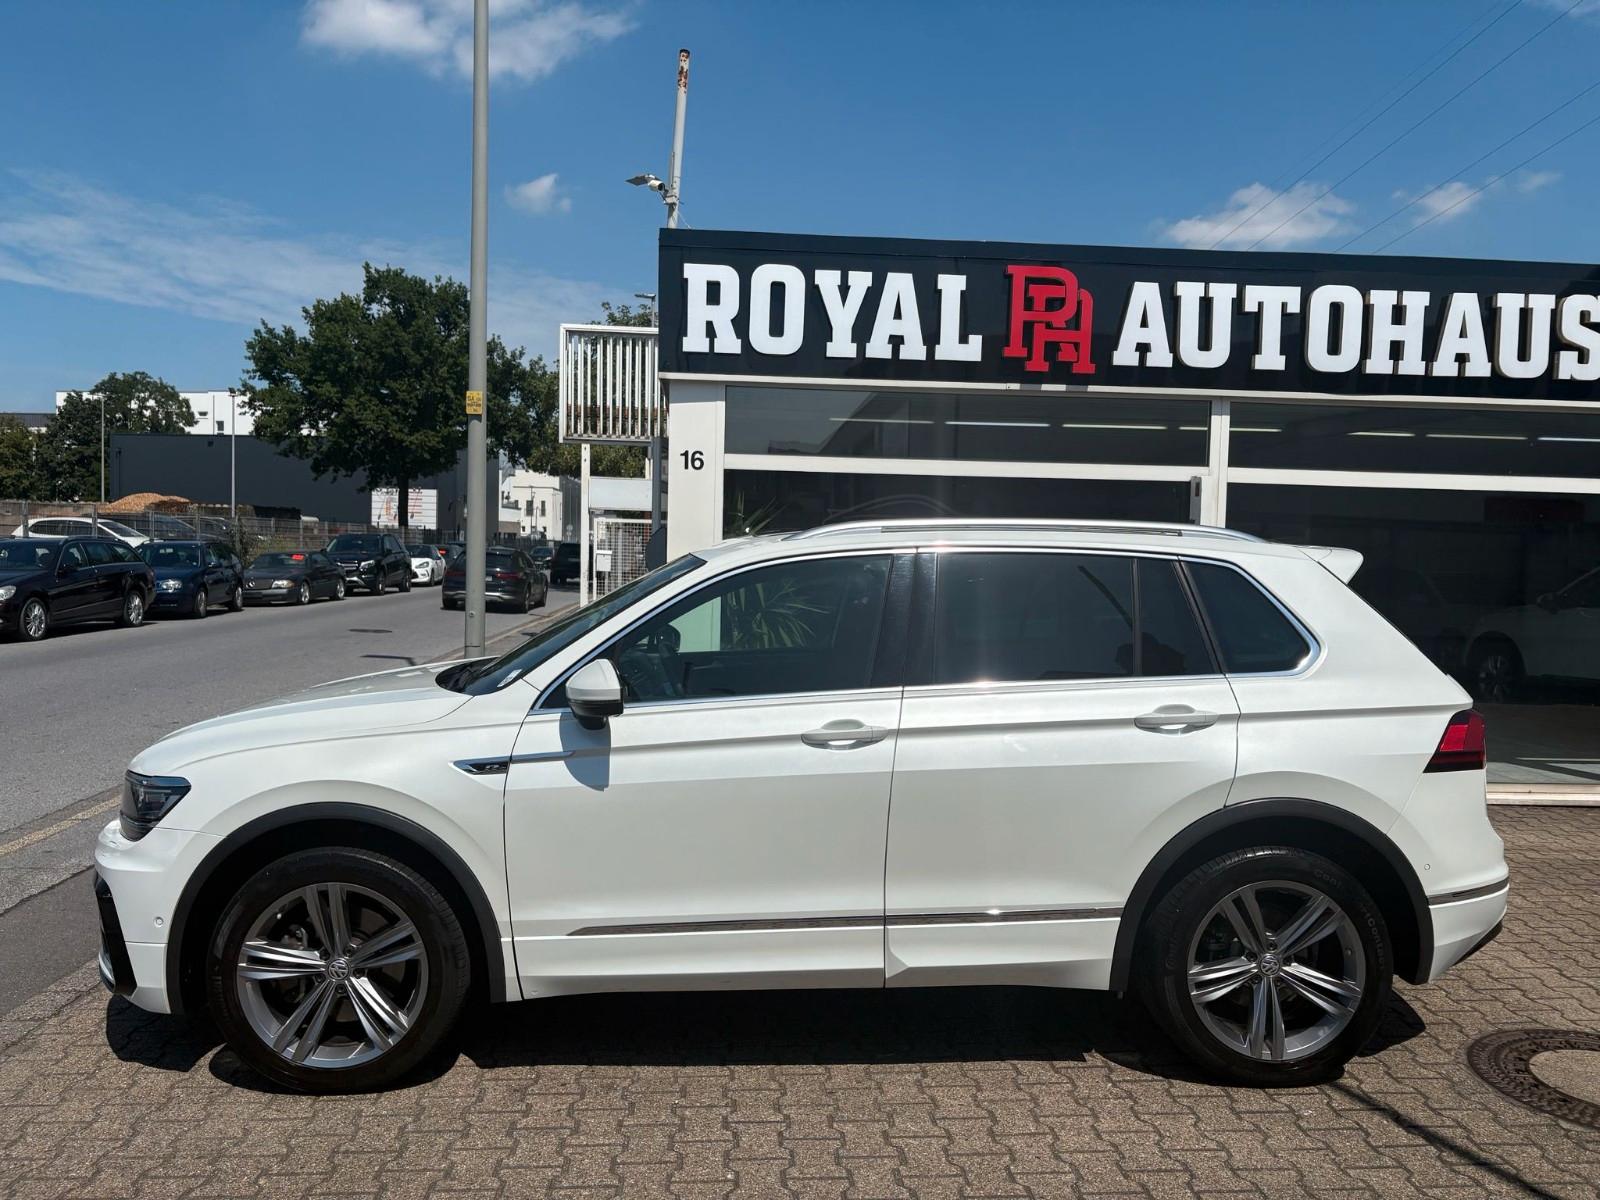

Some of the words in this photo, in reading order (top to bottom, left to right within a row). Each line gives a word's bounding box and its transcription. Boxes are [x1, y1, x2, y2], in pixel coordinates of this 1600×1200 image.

[682, 262, 983, 362] ROYAL
[1111, 280, 1600, 381] AUTOHAUS
[680, 449, 705, 471] 16
